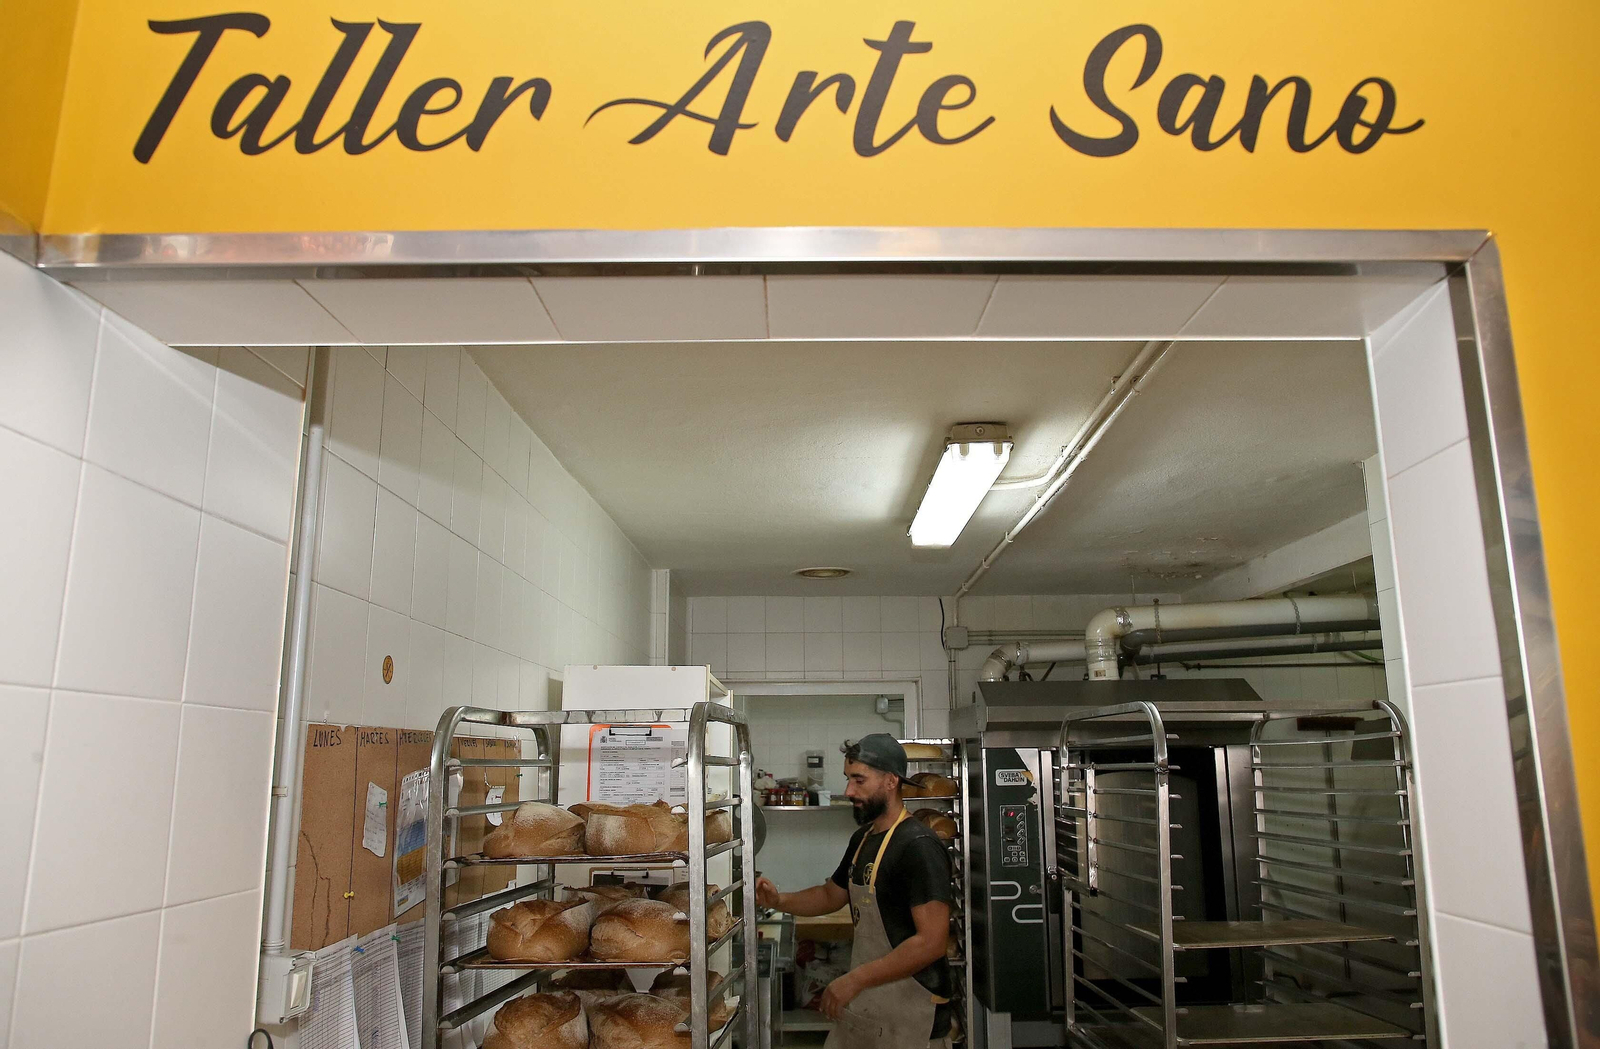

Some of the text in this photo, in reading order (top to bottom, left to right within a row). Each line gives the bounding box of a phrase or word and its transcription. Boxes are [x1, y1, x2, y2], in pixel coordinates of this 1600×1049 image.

[133, 12, 1426, 165] Taller Arte Sano
[313, 729, 342, 748] LUNES
